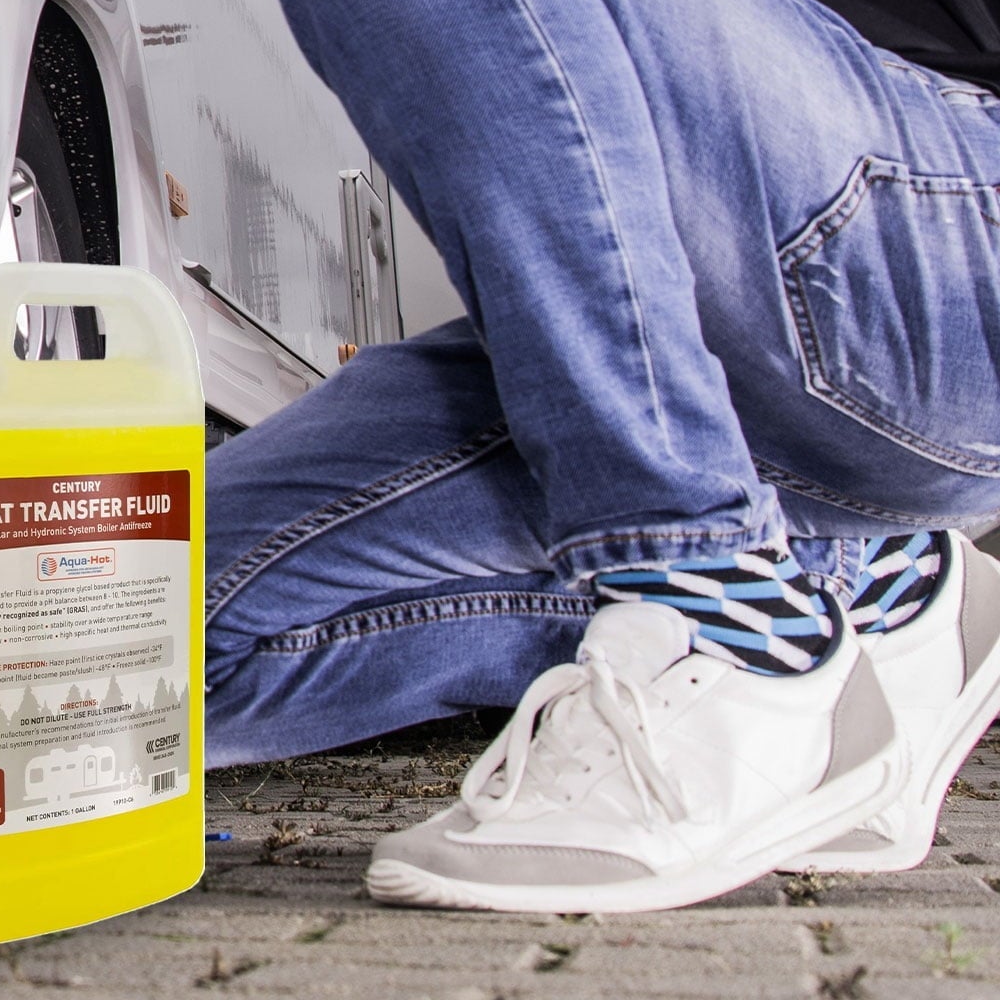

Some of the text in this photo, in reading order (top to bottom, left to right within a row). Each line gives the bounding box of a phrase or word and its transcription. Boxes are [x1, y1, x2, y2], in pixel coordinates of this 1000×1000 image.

[52, 481, 101, 493] CENTURY
[20, 498, 122, 522] TRANSFER
[126, 494, 170, 516] FLUID
[12, 528, 28, 538] and
[30, 527, 66, 538] Hydronic
[68, 526, 95, 536] System
[98, 523, 118, 532] Boiler
[120, 521, 152, 532] Antifreeze
[16, 589, 32, 597] Fluid
[46, 587, 75, 596] propylene
[76, 584, 92, 592] glycol
[111, 580, 130, 590] product
[146, 575, 170, 584] specifically
[2, 609, 40, 620] recognized
[90, 604, 100, 612] and
[102, 602, 114, 610] offer
[116, 601, 124, 609] the
[124, 598, 146, 608] following
[14, 600, 38, 609] provide
[54, 596, 78, 604] balance
[79, 594, 102, 602] between
[121, 590, 130, 598] The
[130, 588, 156, 598] ingredients
[4, 626, 26, 634] boiling
[28, 623, 44, 632] point
[50, 620, 73, 629] stability
[93, 616, 106, 624] wide
[106, 614, 138, 624] temperature
[139, 611, 152, 620] range
[9, 633, 53, 643] non-corrosive
[60, 631, 72, 640] high
[74, 629, 96, 638] specific
[110, 624, 120, 633] and
[120, 622, 140, 630] thermal
[140, 618, 166, 628] conductivity
[2, 660, 48, 670] PROTECTION:
[50, 659, 64, 667] Haze
[66, 656, 80, 666] point
[105, 650, 126, 660] crystals
[34, 670, 58, 680] became
[134, 658, 146, 666] solid
[31, 716, 44, 725] NOT
[46, 713, 68, 722] DILUTE
[74, 710, 86, 719] USE
[88, 708, 102, 716] FULL
[103, 704, 132, 715] STRENGTH
[60, 699, 98, 711] DIRECTIONS:
[41, 722, 94, 734] recommendations
[120, 710, 148, 722] introduction
[10, 740, 32, 750] system
[34, 736, 69, 746] preparation
[70, 732, 82, 740] and
[82, 730, 96, 738] fluid
[155, 733, 180, 748] CENTURY
[39, 810, 70, 820] CONTENTS:
[75, 804, 96, 814] GALLON
